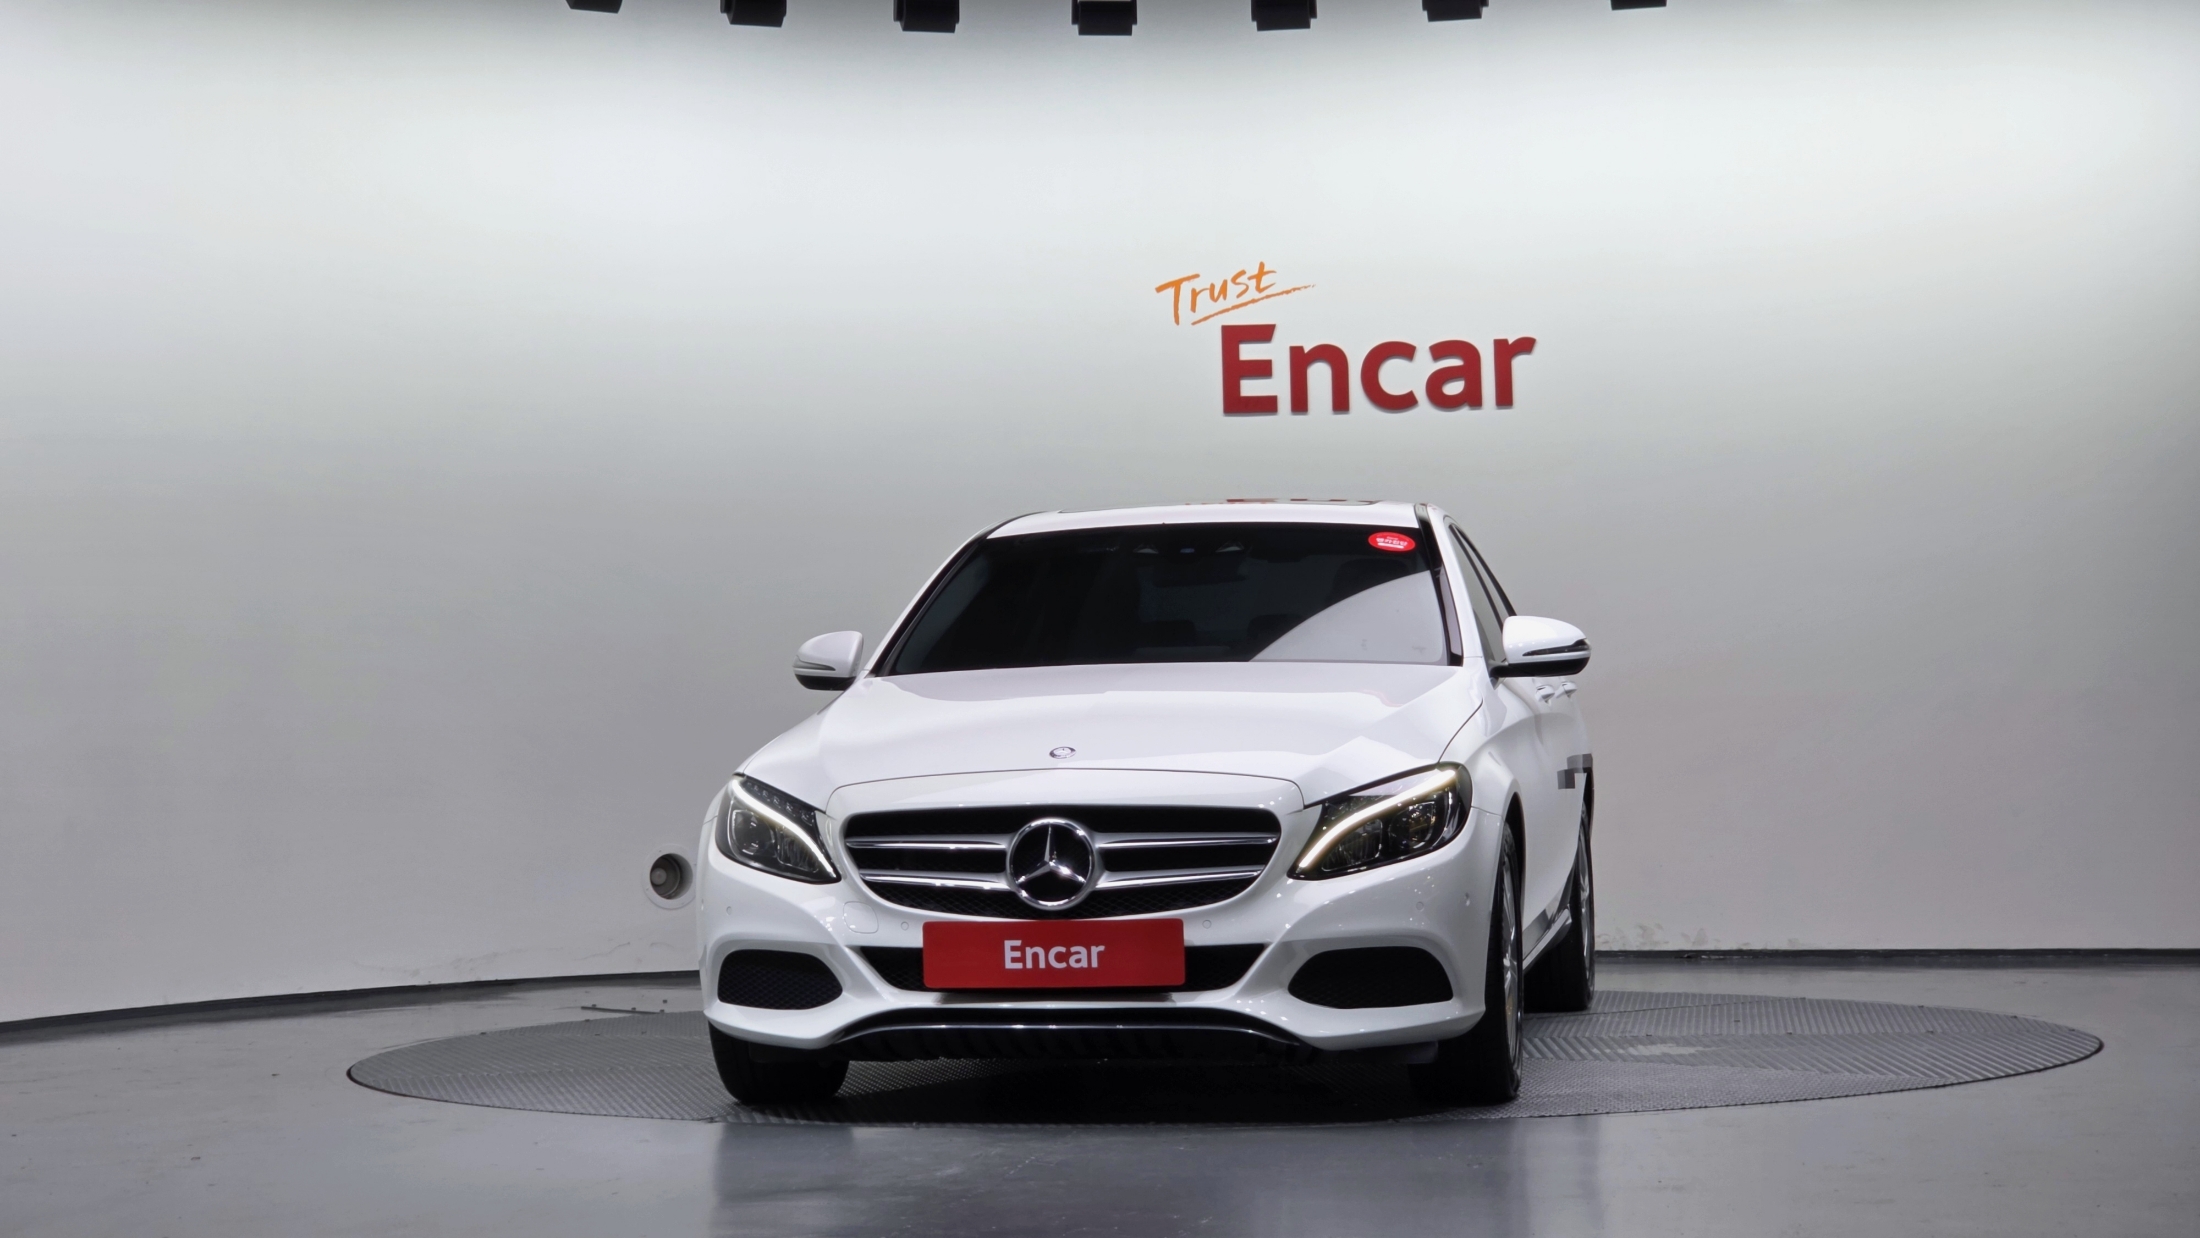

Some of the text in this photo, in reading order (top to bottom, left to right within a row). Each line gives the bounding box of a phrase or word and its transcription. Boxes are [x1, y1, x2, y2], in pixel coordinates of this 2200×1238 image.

[1155, 261, 1277, 325] Trust
[1221, 324, 1537, 414] Encar
[1004, 940, 1105, 969] Encar
